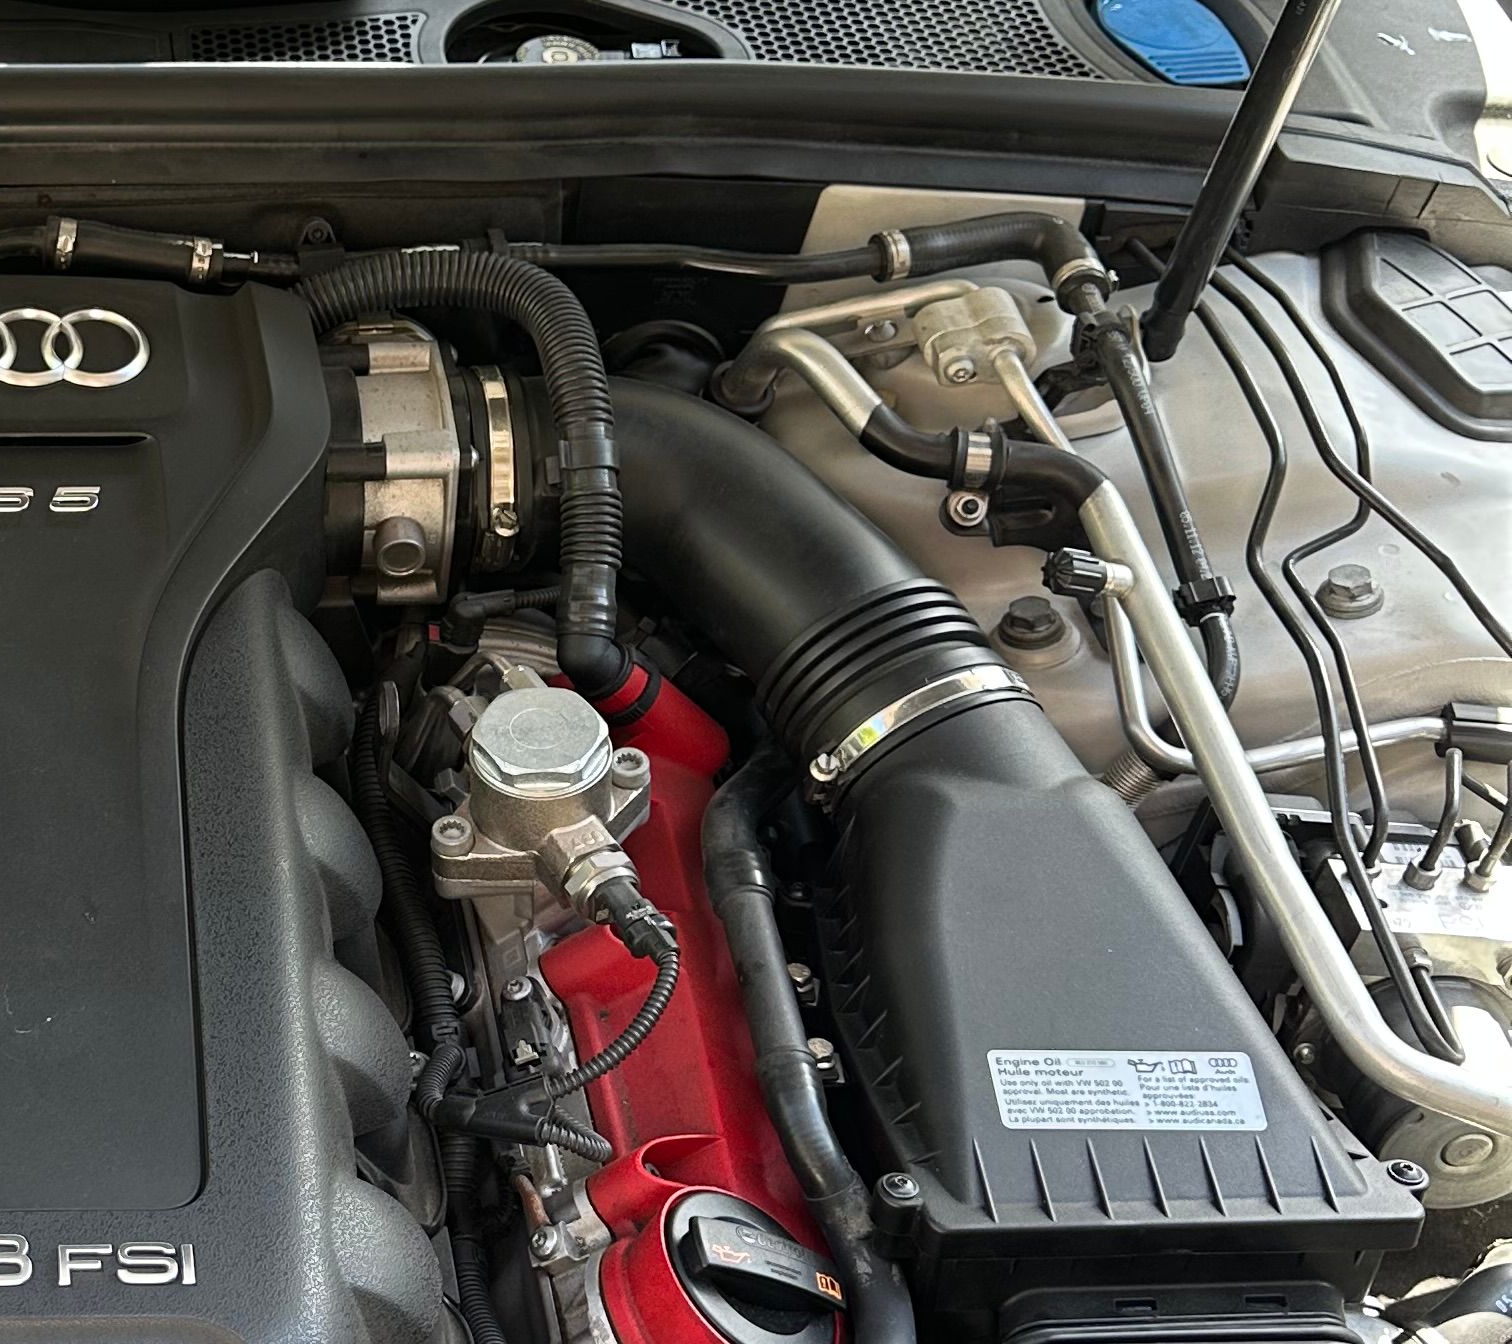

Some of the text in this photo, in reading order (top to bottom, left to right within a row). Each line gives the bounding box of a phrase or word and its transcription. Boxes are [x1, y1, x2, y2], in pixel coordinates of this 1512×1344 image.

[49, 486, 101, 513] 5
[996, 1057, 1061, 1067] Engine Oil
[998, 1068, 1084, 1076] Huile moteur
[1000, 1080, 1017, 1088] Use
[1019, 1080, 1039, 1088] only
[1054, 1080, 1074, 1088] with
[1076, 1080, 1091, 1088] VW
[1093, 1080, 1110, 1088] 502
[1138, 1075, 1152, 1083] For
[1162, 1075, 1175, 1083] list
[1188, 1076, 1230, 1084] approved
[1045, 1088, 1069, 1097] Most
[1070, 1088, 1085, 1097] are
[1140, 1084, 1237, 1092] Pour une liste d'huiles
[1094, 1099, 1111, 1107] des
[1008, 1108, 1028, 1116] avec
[1030, 1108, 1045, 1116] VW
[1047, 1108, 1063, 1116] 502
[1078, 1108, 1134, 1116] approbation.
[1021, 1116, 1053, 1125] plupart
[1055, 1117, 1075, 1125] sont
[58, 1242, 196, 1286] FSI
